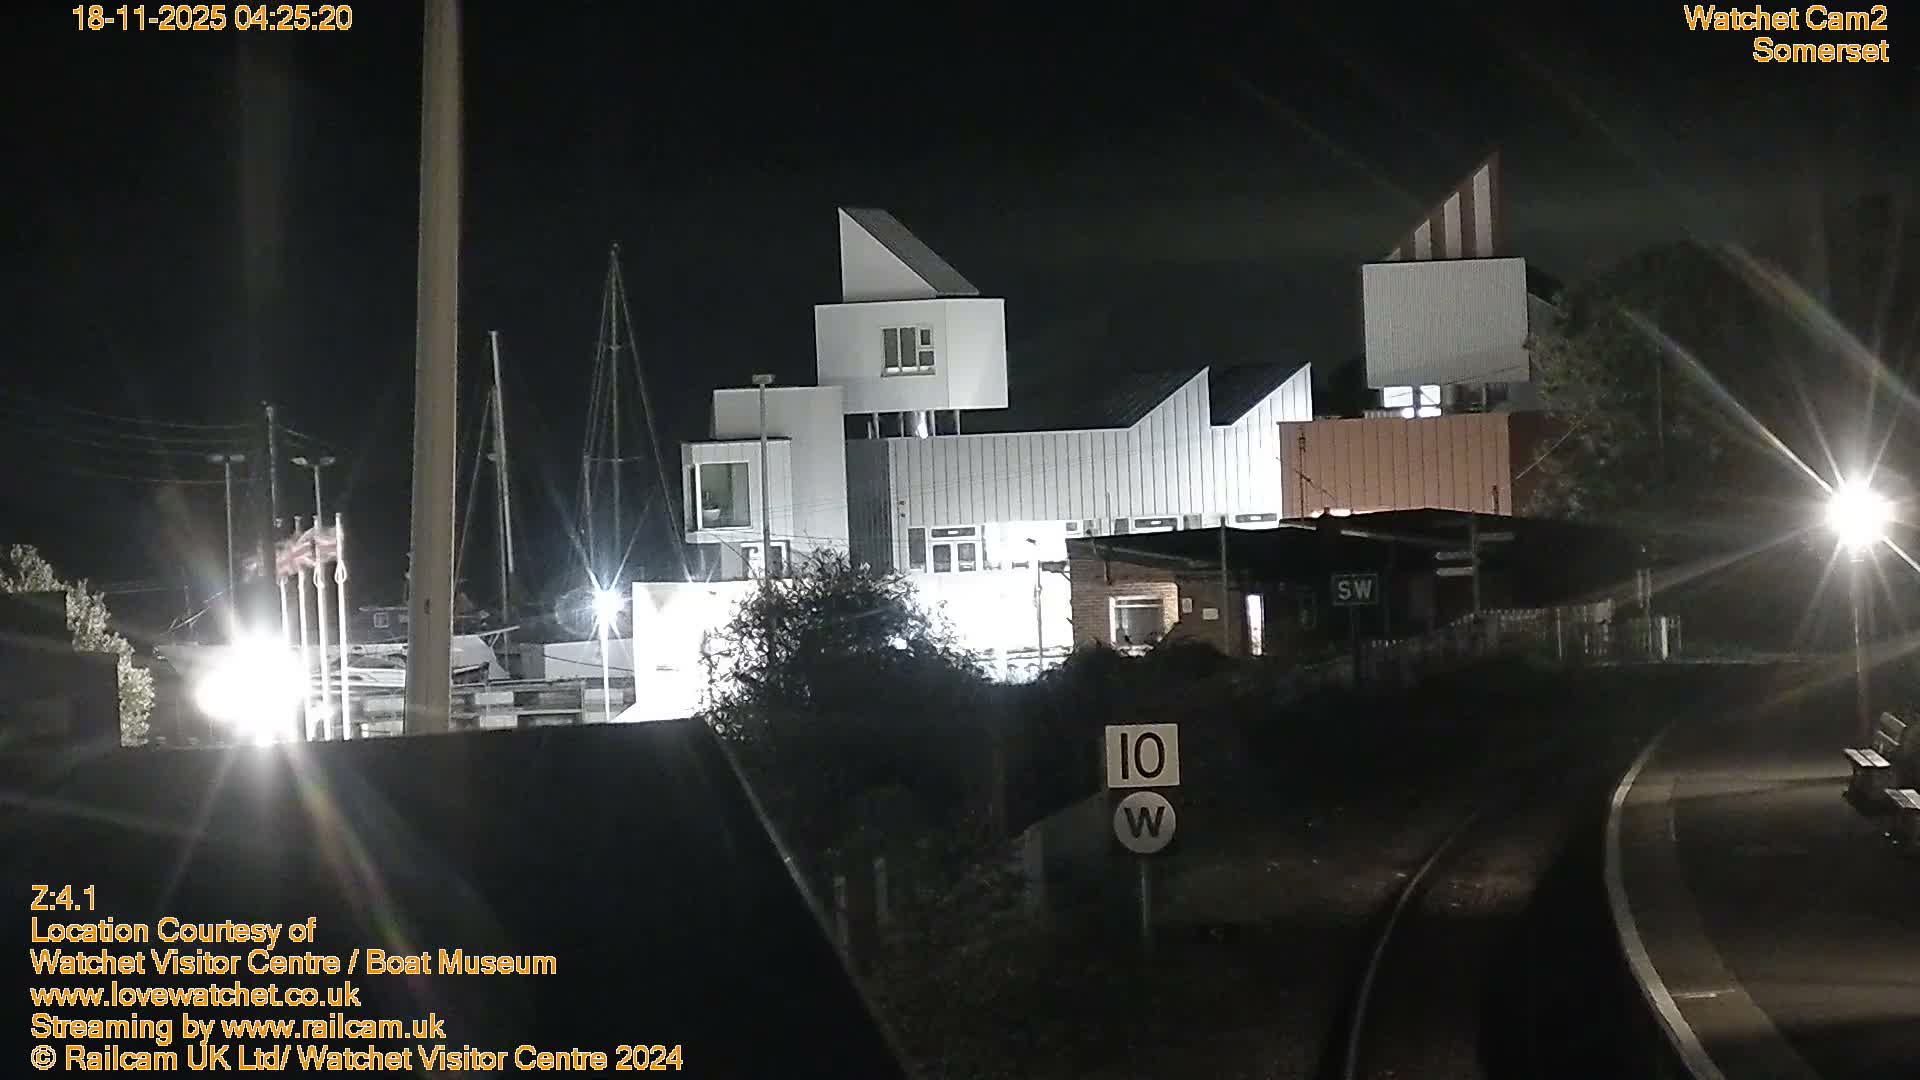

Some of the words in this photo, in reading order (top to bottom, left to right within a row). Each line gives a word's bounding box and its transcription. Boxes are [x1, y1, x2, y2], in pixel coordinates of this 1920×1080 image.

[1338, 579, 1372, 600] SW
[1121, 732, 1165, 780] 10
[1124, 806, 1165, 838] W
